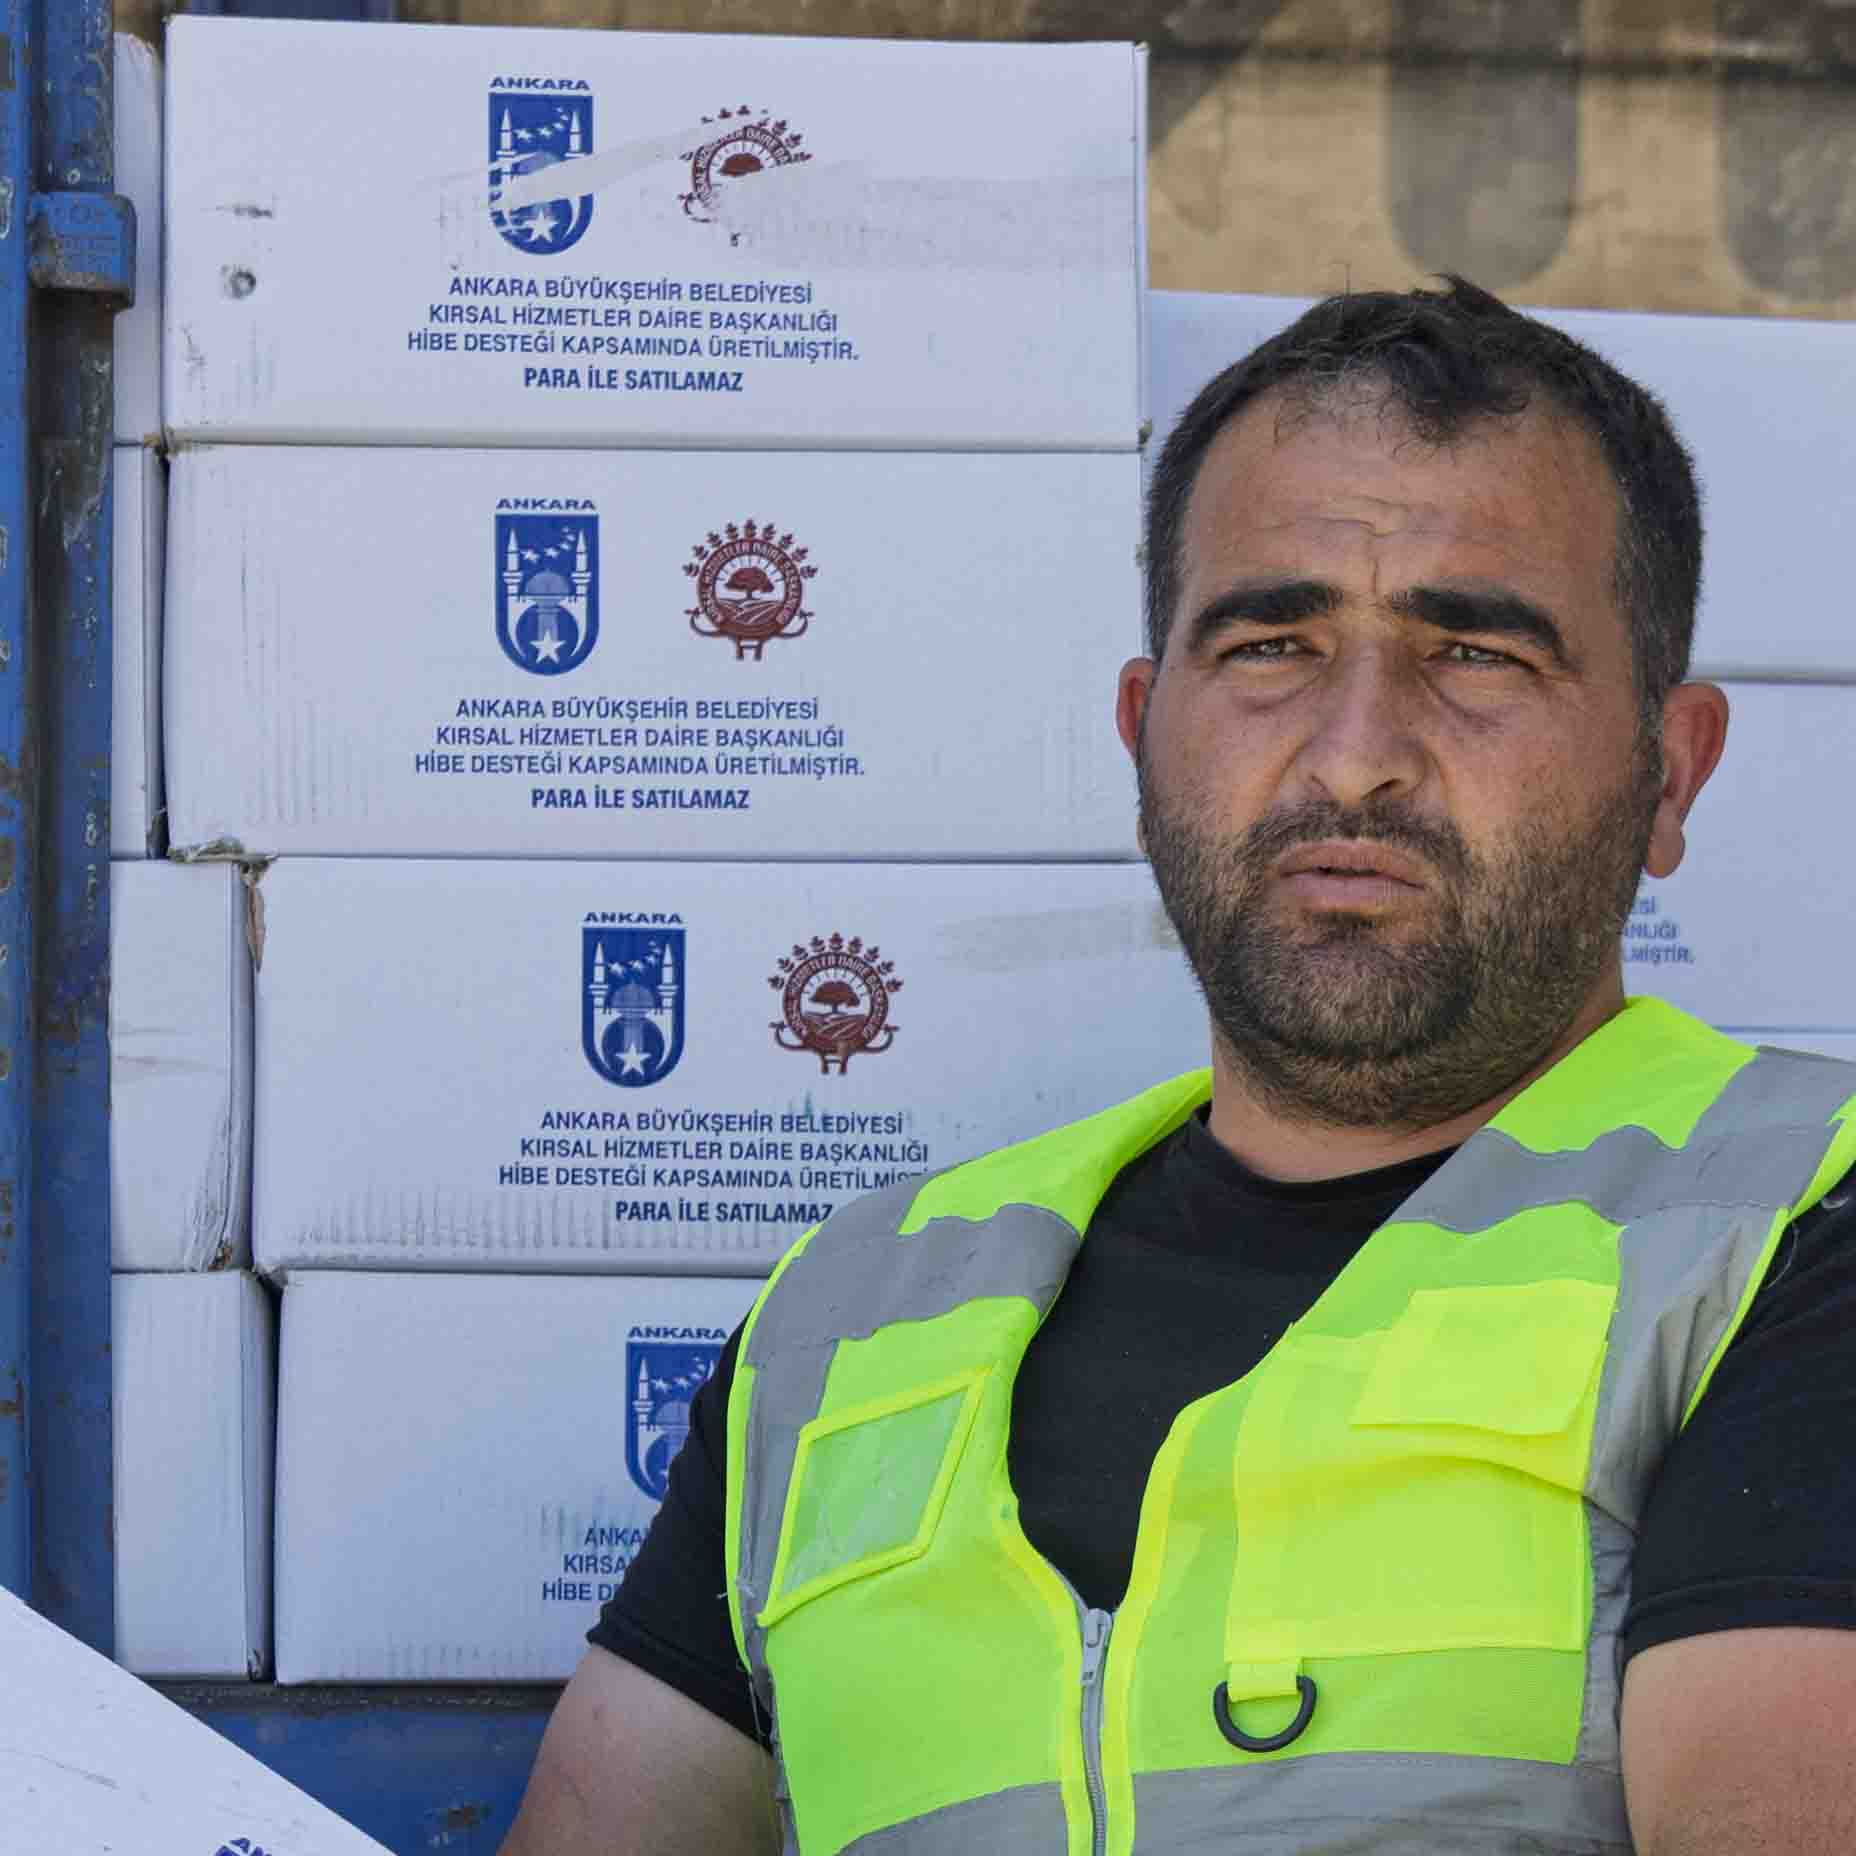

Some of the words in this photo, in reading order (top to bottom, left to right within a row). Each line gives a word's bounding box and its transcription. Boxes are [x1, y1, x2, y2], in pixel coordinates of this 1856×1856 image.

[490, 77, 590, 92] ANKARA
[448, 277, 538, 299] ANKARA
[545, 277, 683, 304] BÜYÜKŞEHİR
[690, 279, 812, 305] BELEDİYESİ
[428, 304, 506, 324] KIRSAL
[513, 302, 632, 328] HİZMETLER
[639, 306, 702, 329] DAİRE
[710, 307, 837, 334] BAŞKANLIĞI
[407, 328, 457, 351] HİBE
[463, 330, 555, 354] DESTEĞİ
[562, 335, 702, 357] KAPSAMINDA
[709, 335, 858, 364] ÜRETİLMİŞTİR.
[525, 368, 581, 388] PARA
[588, 365, 618, 389] İLE
[625, 370, 743, 392] SATILAMAZ
[496, 499, 596, 511] ANKARA
[456, 700, 545, 720] ANKARA
[552, 698, 689, 722] BÜYÜKŞEHİR
[696, 697, 818, 720] BELEDİYESİ
[436, 727, 513, 745] KIRSAL
[520, 723, 638, 747] HİZMETLER
[645, 724, 708, 747] DAİRE
[716, 724, 843, 752] BAŞKANLIĞI
[415, 750, 464, 773] HİBE
[471, 751, 562, 774] DESTEĞİ
[569, 755, 708, 775] KAPSAMINDA
[715, 751, 864, 780] ÜRETİLMİŞTİR.
[532, 789, 587, 808] PARA
[594, 785, 625, 808] İLE
[632, 789, 749, 809] SATILAMAZ
[584, 911, 683, 924] ANKARA
[541, 1112, 630, 1132] ANKARA
[637, 1110, 773, 1136] BÜYÜKŞEHİR
[780, 1109, 903, 1135] BELEDİYESİ
[521, 1138, 597, 1158] KIRSAL
[604, 1135, 722, 1160] HİZMETLER
[729, 1138, 792, 1161] DAİRE
[800, 1138, 928, 1165] BAŞKANLIĞI
[500, 1162, 548, 1185] HİBE
[555, 1164, 646, 1187] DESTEĞİ
[653, 1168, 792, 1189] KAPSAMINDA
[616, 1201, 672, 1221] PARA
[678, 1198, 709, 1221] İLE
[628, 1327, 730, 1343] ANKARA
[542, 1578, 591, 1601] HİBE
